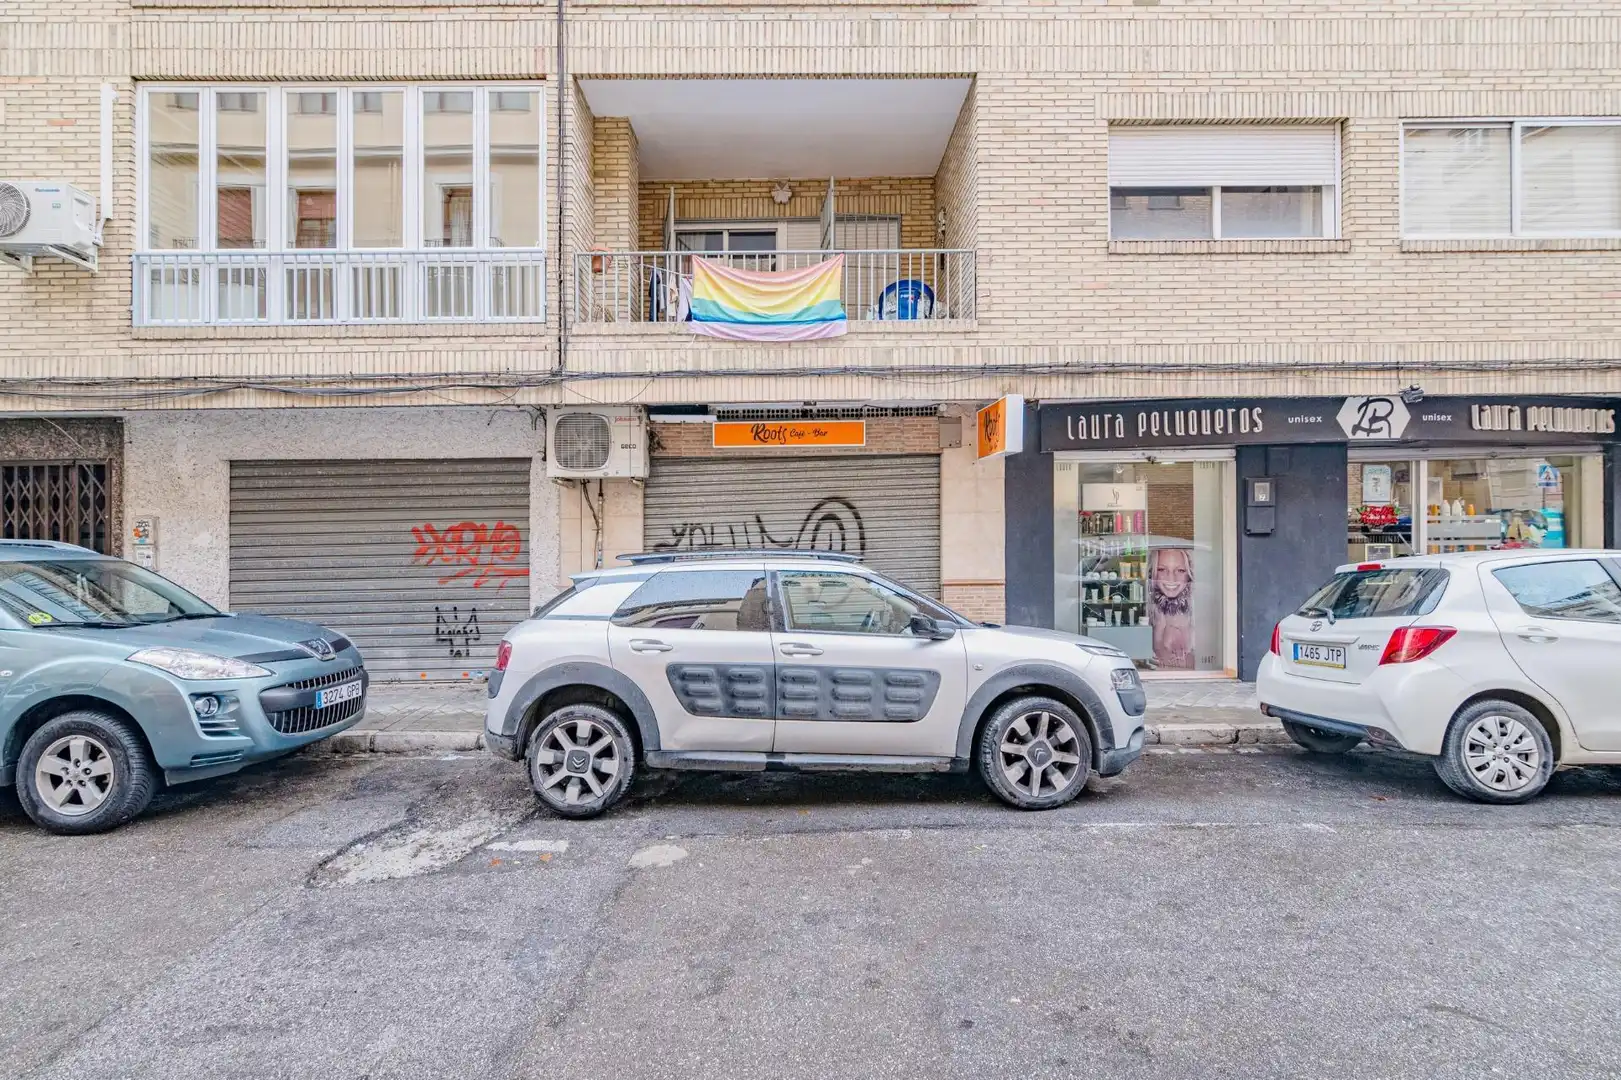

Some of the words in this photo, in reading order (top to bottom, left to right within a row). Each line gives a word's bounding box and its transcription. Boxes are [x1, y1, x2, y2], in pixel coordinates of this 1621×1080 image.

[1288, 415, 1322, 424] unisex
[1422, 413, 1452, 422] unisex
[751, 423, 787, 445] Roots
[1299, 644, 1320, 660] 1465
[1324, 647, 1342, 662] JTP
[323, 688, 343, 705] 3274
